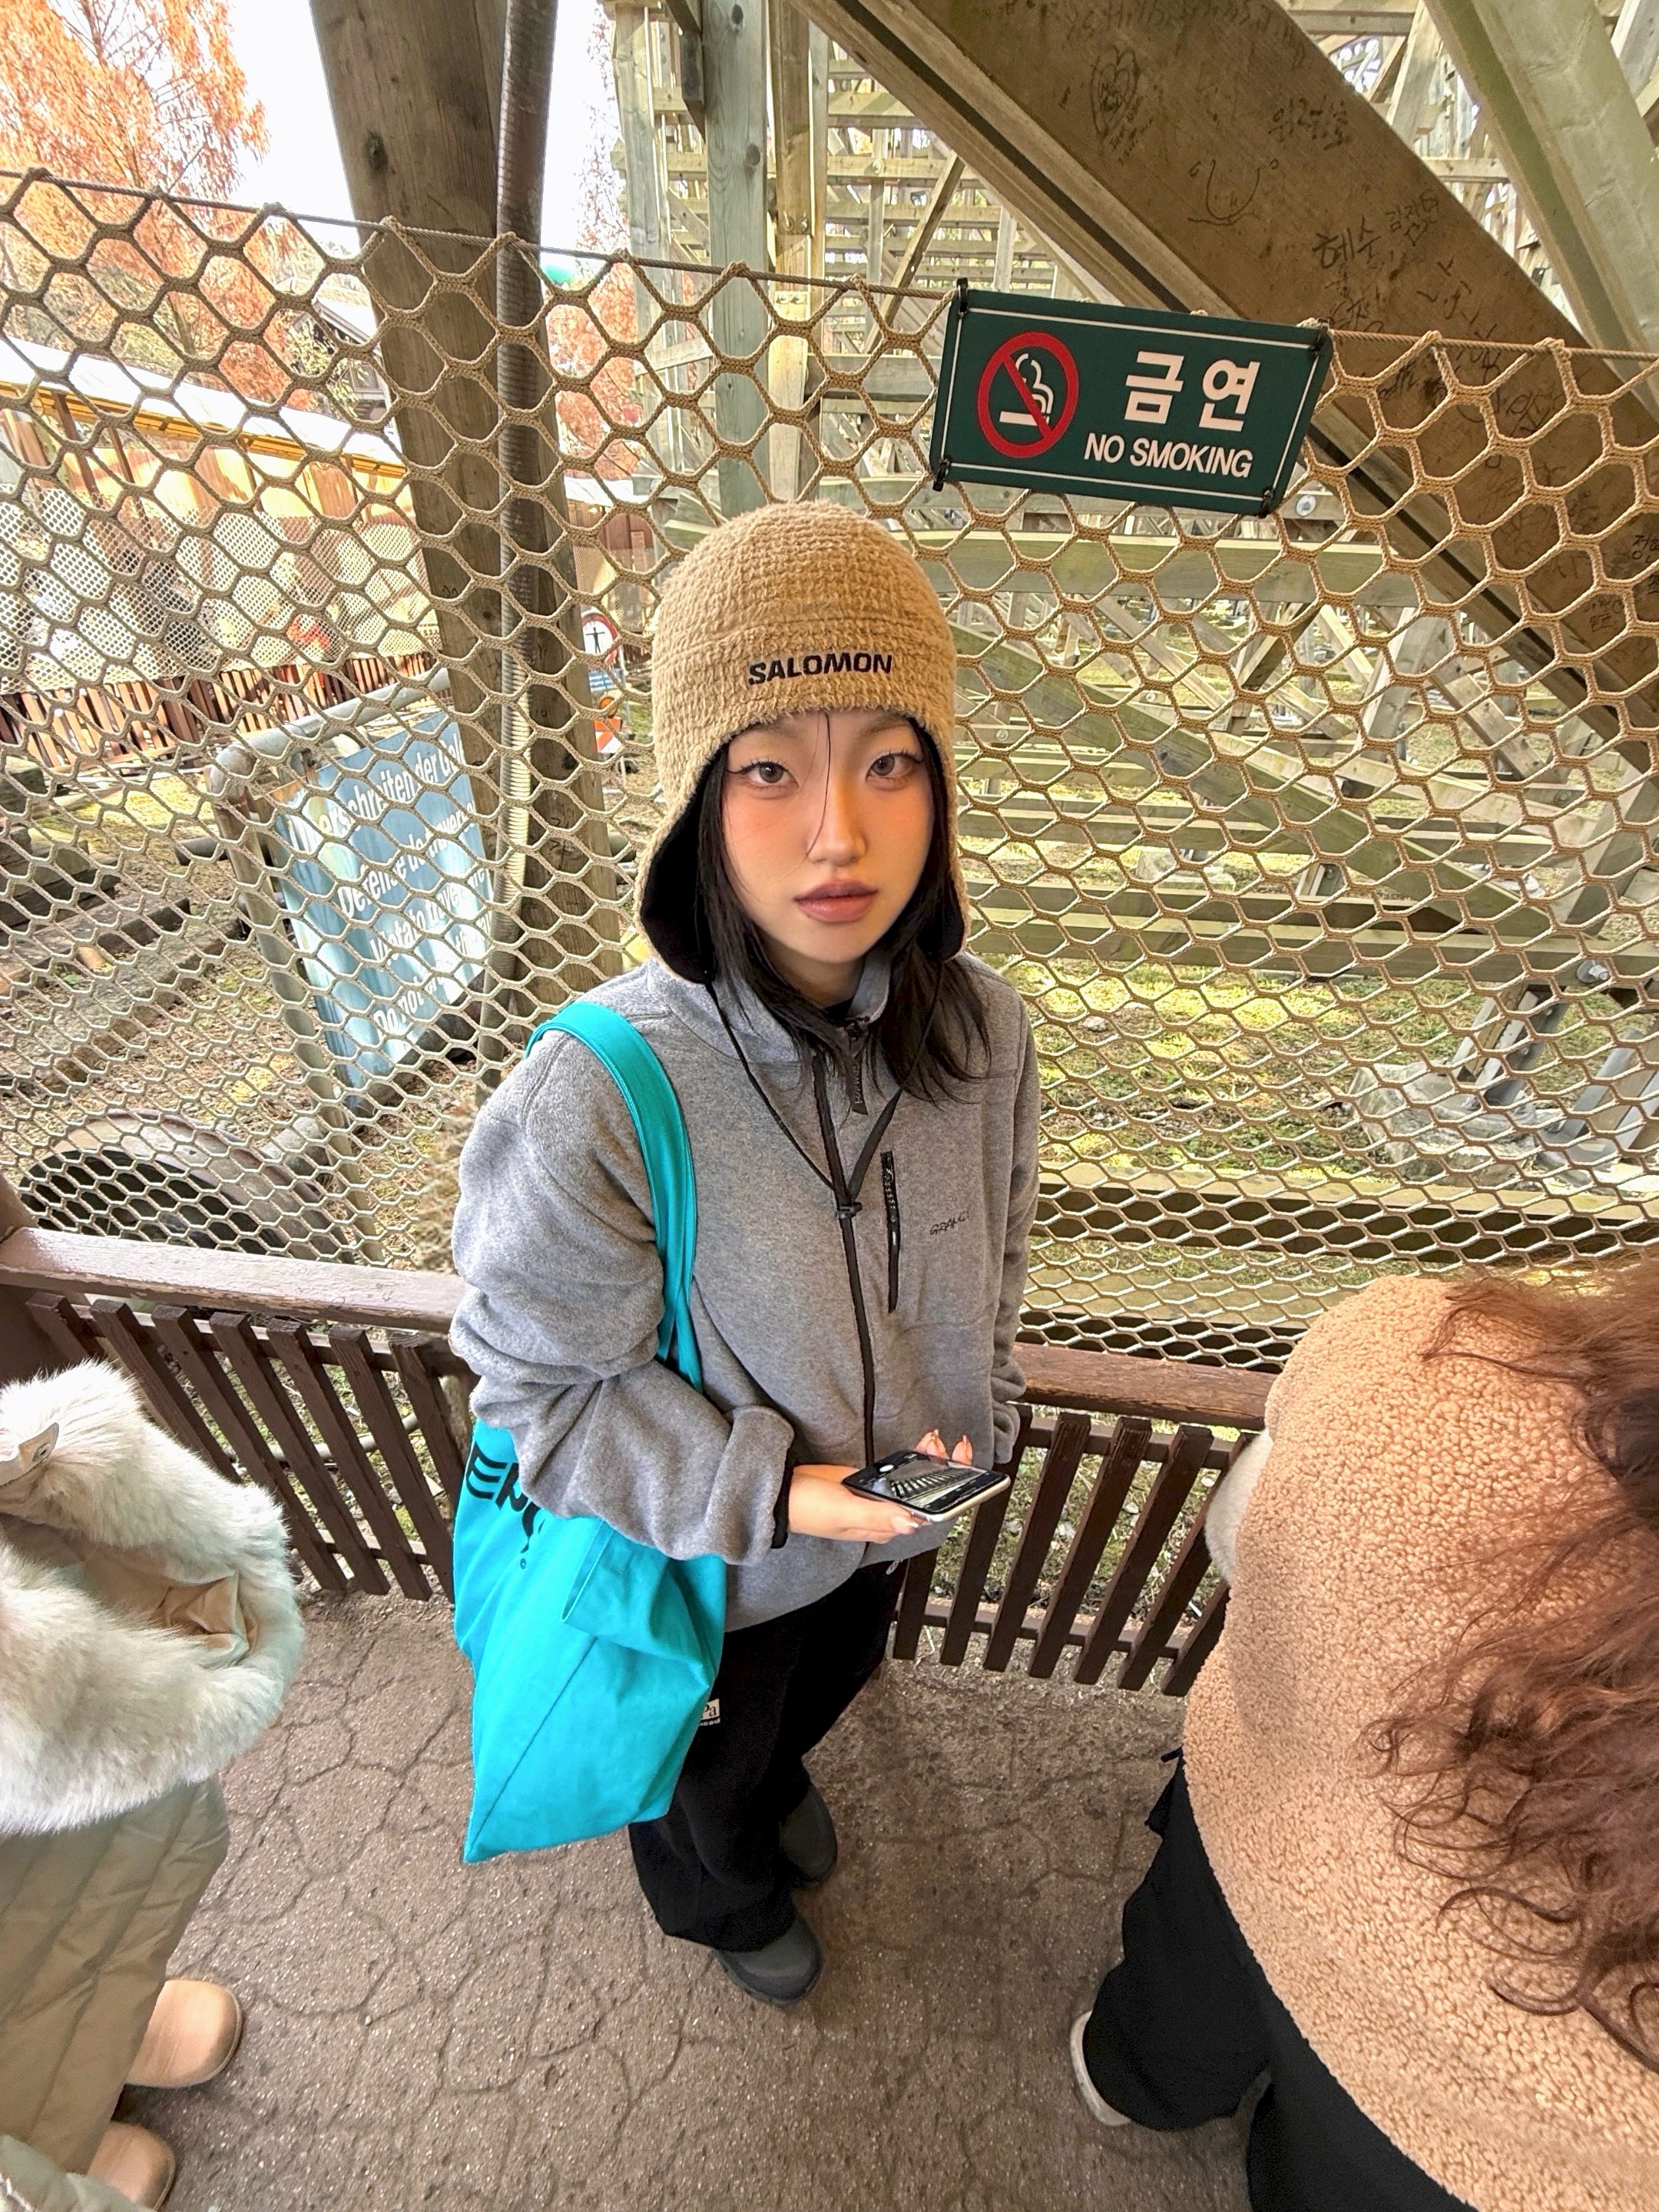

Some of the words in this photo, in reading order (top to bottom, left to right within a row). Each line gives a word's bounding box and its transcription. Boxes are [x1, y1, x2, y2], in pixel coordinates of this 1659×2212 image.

[1124, 350, 1261, 432] 금연
[1084, 432, 1125, 464] NO
[1129, 436, 1253, 478] SMOKING
[748, 652, 892, 686] SALOMON
[414, 753, 438, 790] der
[373, 1007, 396, 1040] Do
